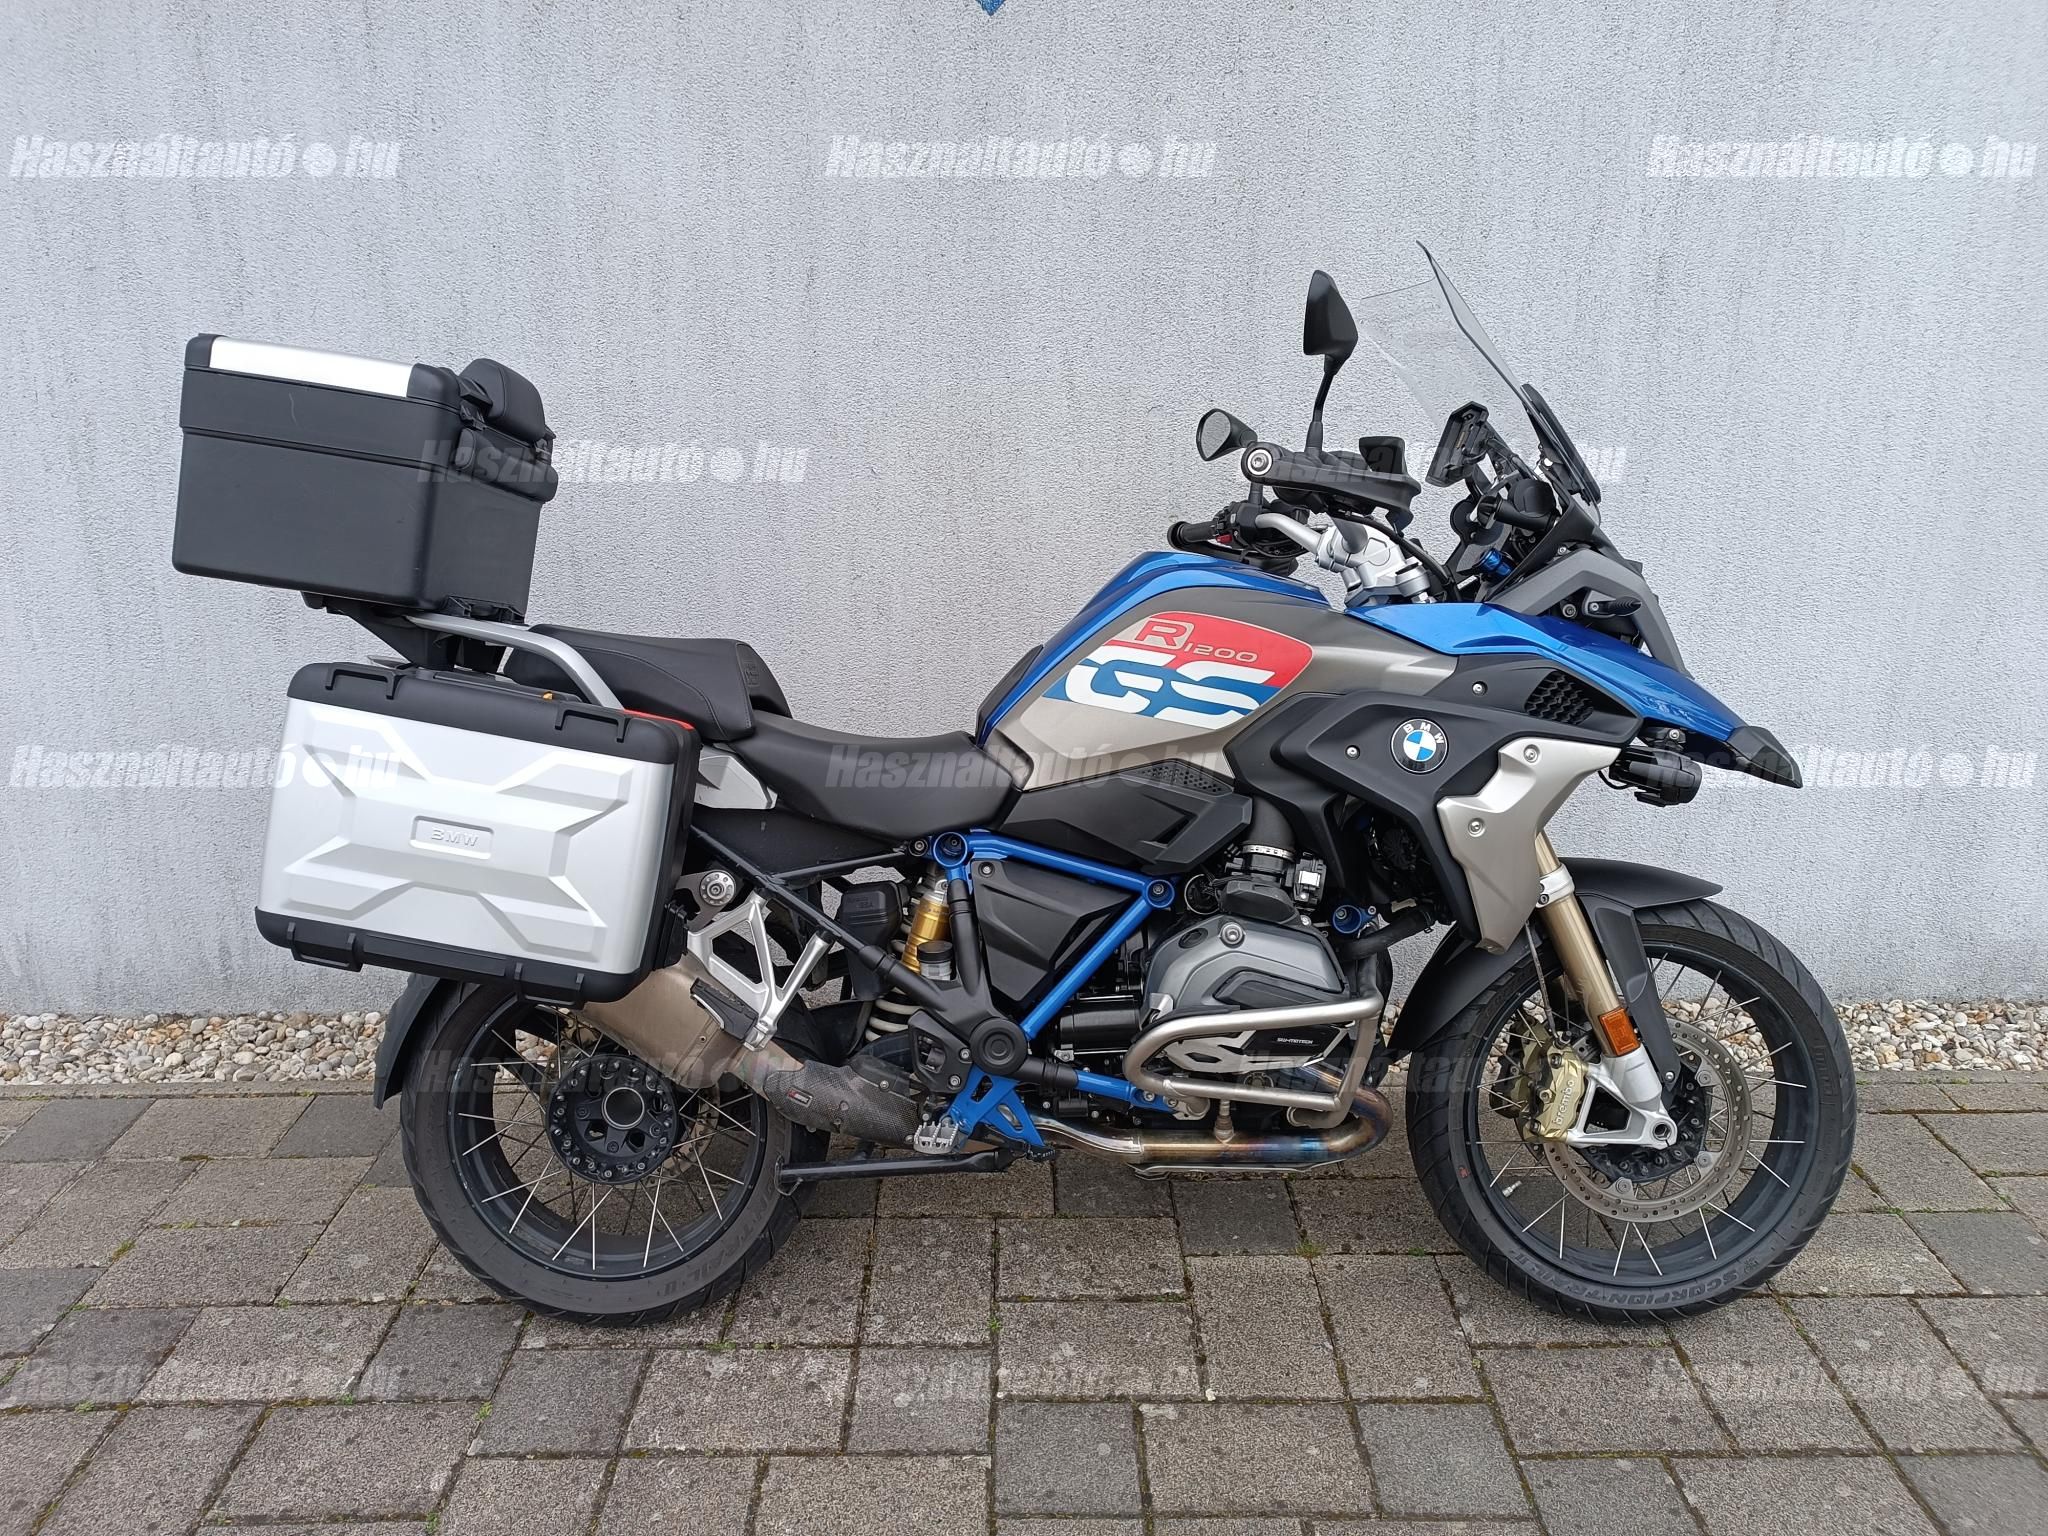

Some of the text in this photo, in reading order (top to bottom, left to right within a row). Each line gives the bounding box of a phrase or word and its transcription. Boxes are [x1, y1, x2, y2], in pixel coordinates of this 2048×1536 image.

[1184, 642, 1258, 664] 1200
[1064, 645, 1276, 730] GS
[1402, 721, 1445, 744] BMW
[430, 827, 480, 847] BMW
[1552, 1080, 1576, 1126] brembo
[1529, 1264, 1602, 1301] TRAIL
[1608, 1268, 1739, 1306] SCORPION
